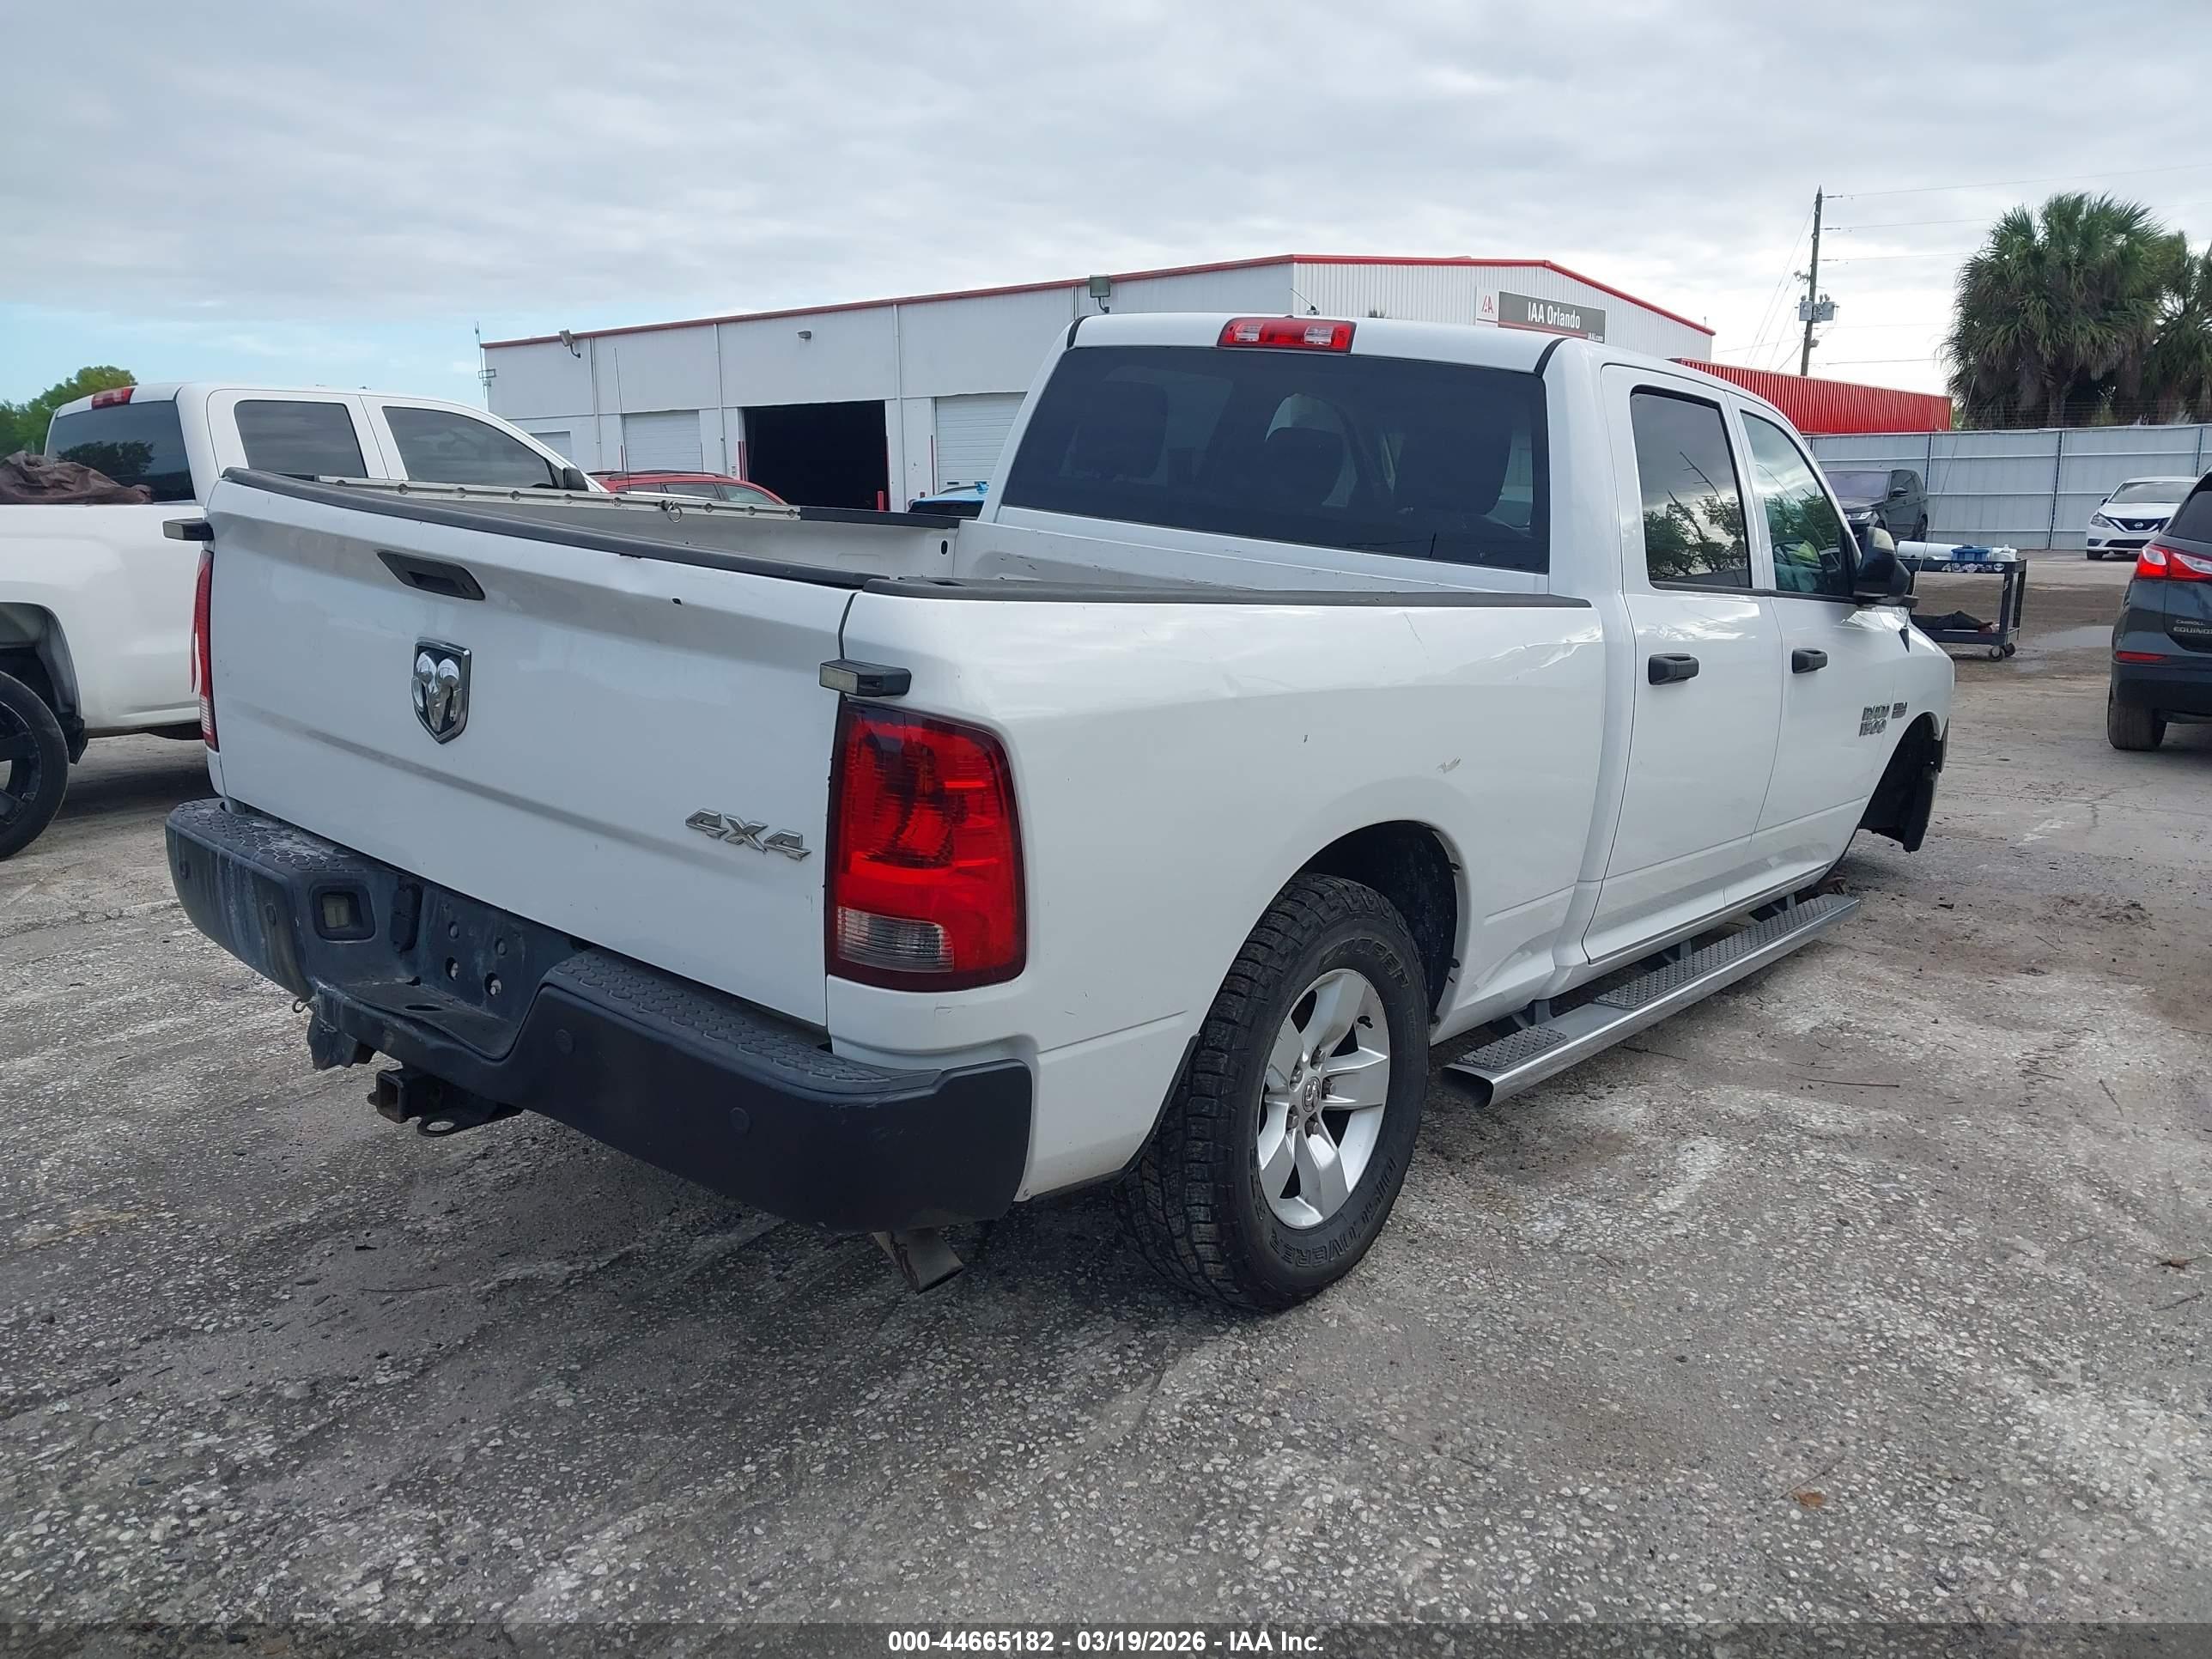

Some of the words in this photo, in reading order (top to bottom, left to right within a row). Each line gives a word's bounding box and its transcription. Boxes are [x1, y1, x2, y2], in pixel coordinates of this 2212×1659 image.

[1528, 301, 1545, 324] IAA
[1547, 305, 1581, 329] Orlando
[1862, 704, 1890, 721] RAM
[1318, 936, 1410, 988] COOPER
[1268, 1156, 1398, 1269] DISCOVERER
